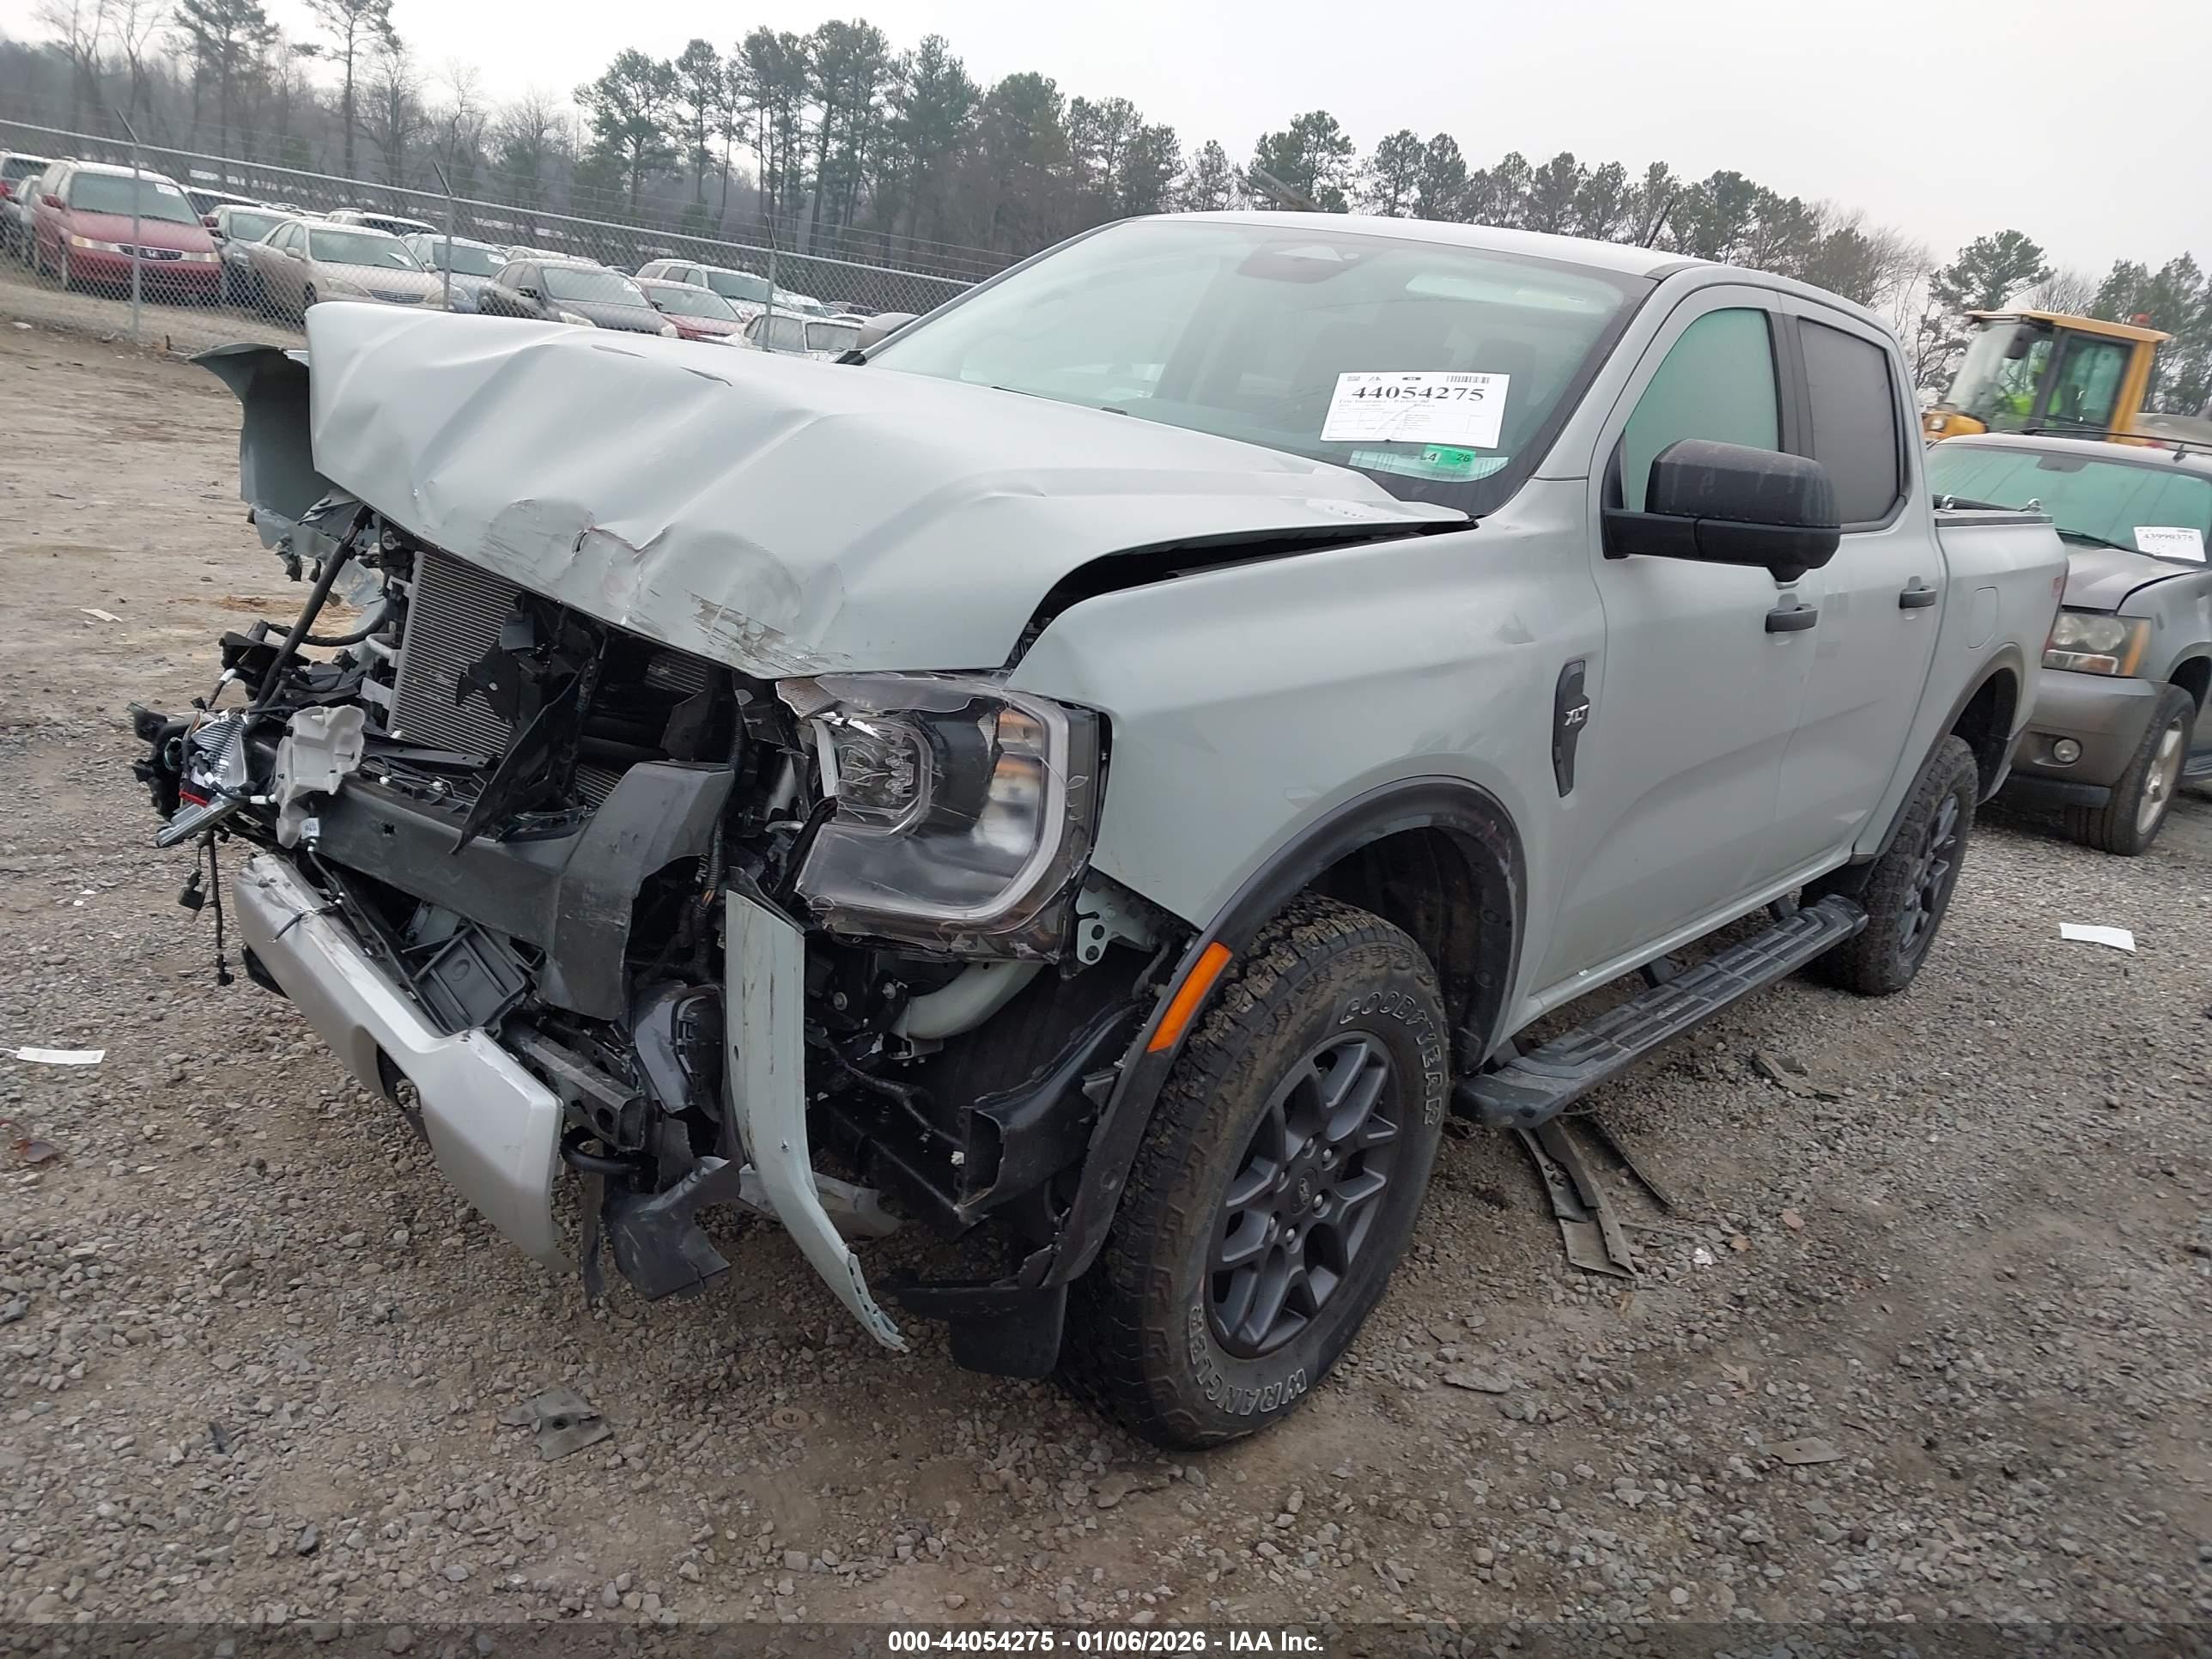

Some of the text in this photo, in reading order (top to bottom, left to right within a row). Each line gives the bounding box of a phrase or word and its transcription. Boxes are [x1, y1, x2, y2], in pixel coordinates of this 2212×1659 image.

[1351, 386, 1485, 402] 44054275
[1564, 704, 1589, 726] XLT
[1339, 990, 1443, 1126] GOODYEAR
[1188, 1303, 1308, 1416] WRANGLER
